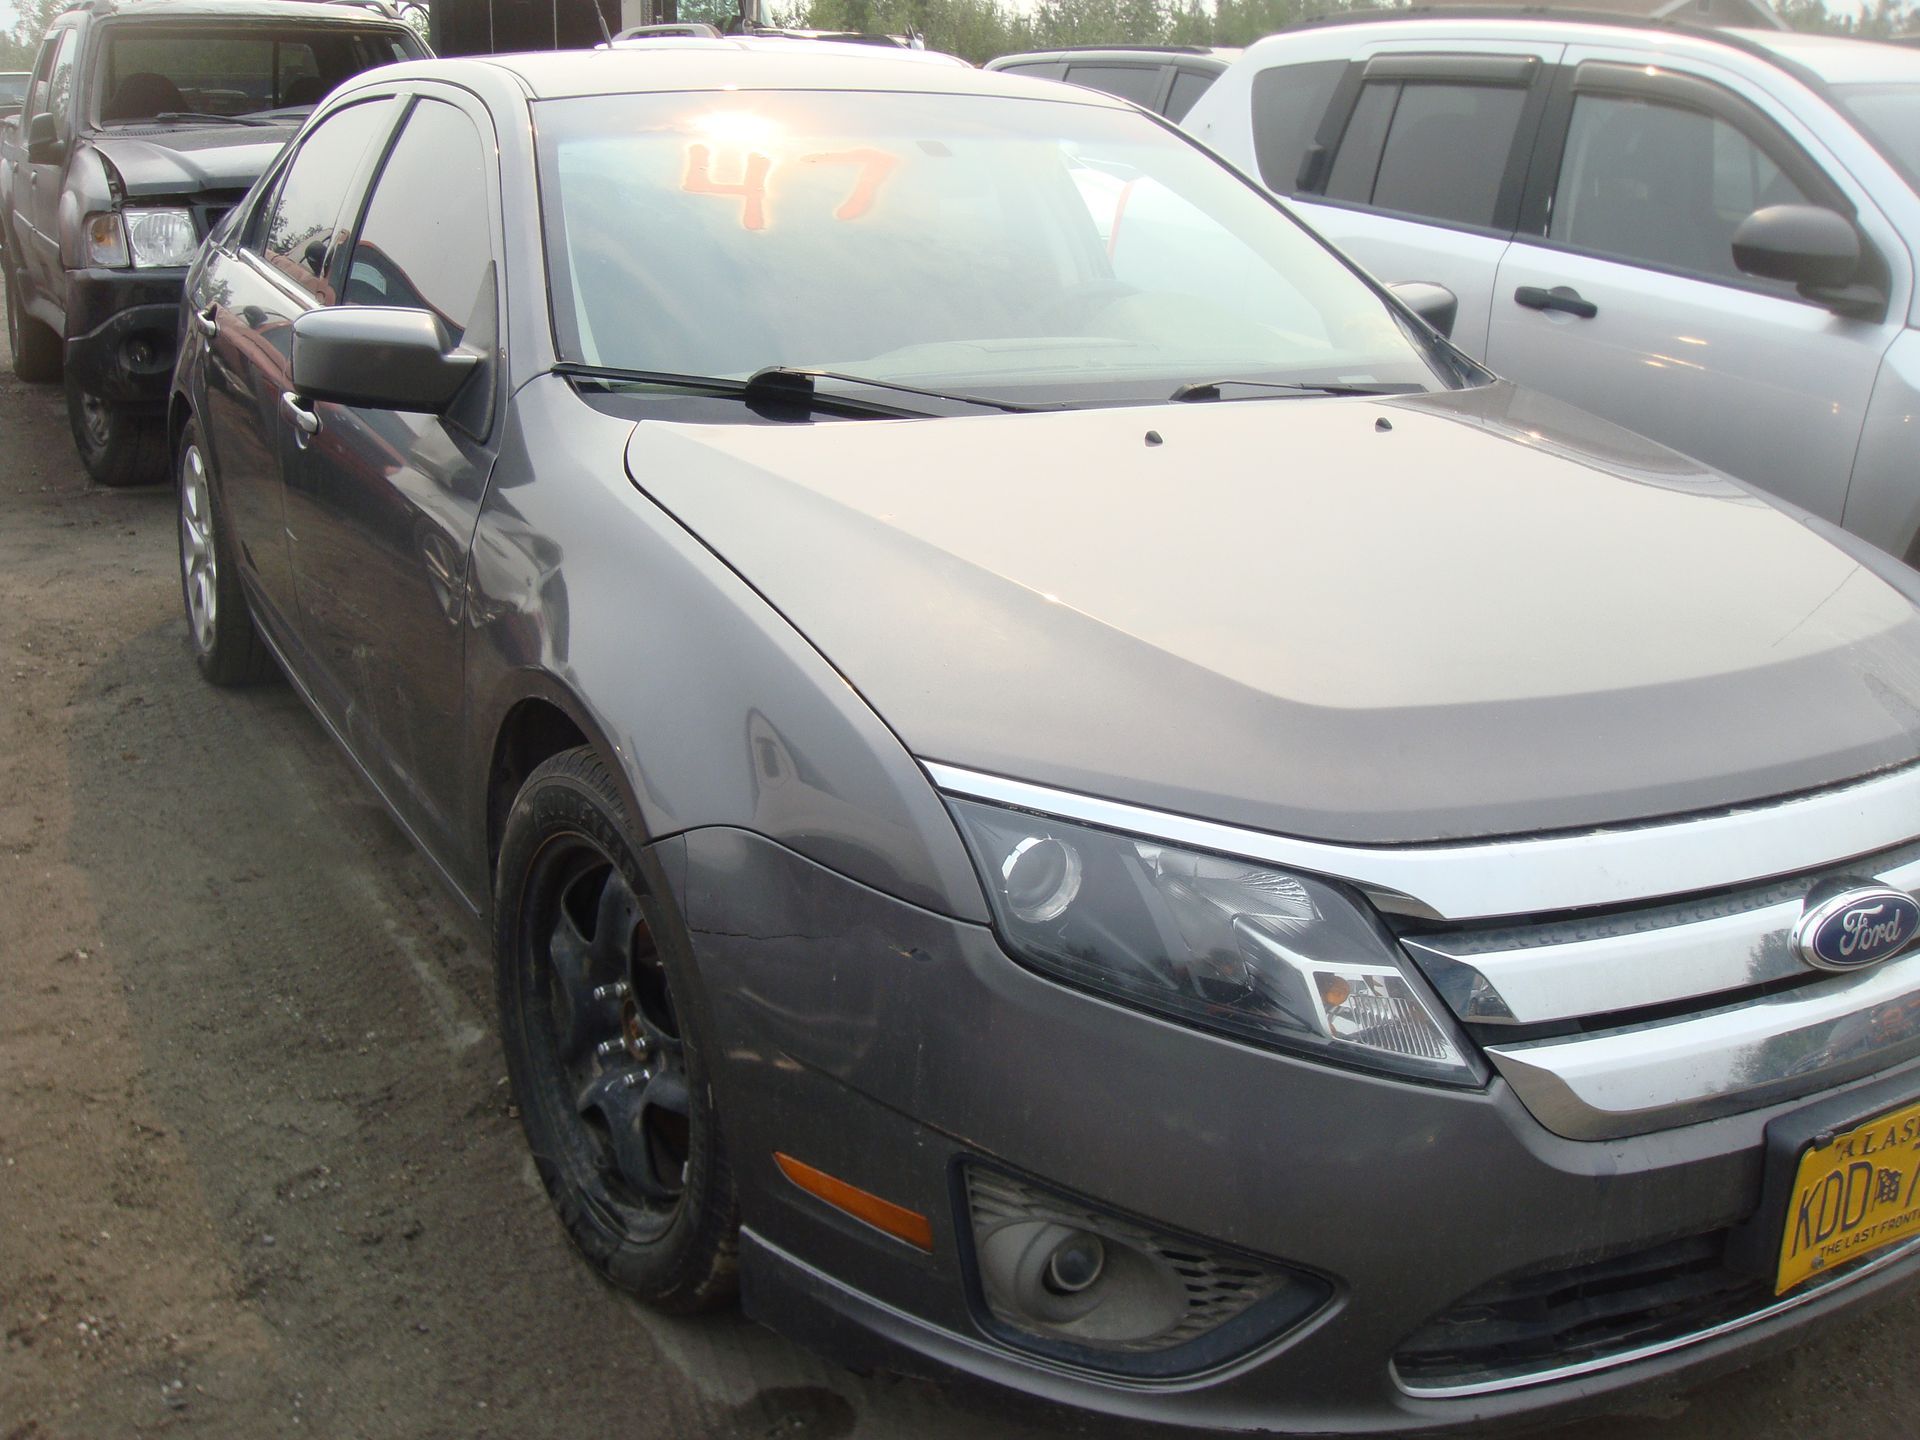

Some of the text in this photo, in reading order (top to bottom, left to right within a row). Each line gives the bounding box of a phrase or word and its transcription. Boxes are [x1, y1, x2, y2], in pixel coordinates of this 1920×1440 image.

[681, 143, 898, 230] 47
[1839, 904, 1902, 956] Ford
[1837, 1114, 1920, 1162] ALAS
[1791, 1160, 1873, 1258] KDD
[1819, 1238, 1842, 1258] THE
[1845, 1223, 1878, 1248] LAST
